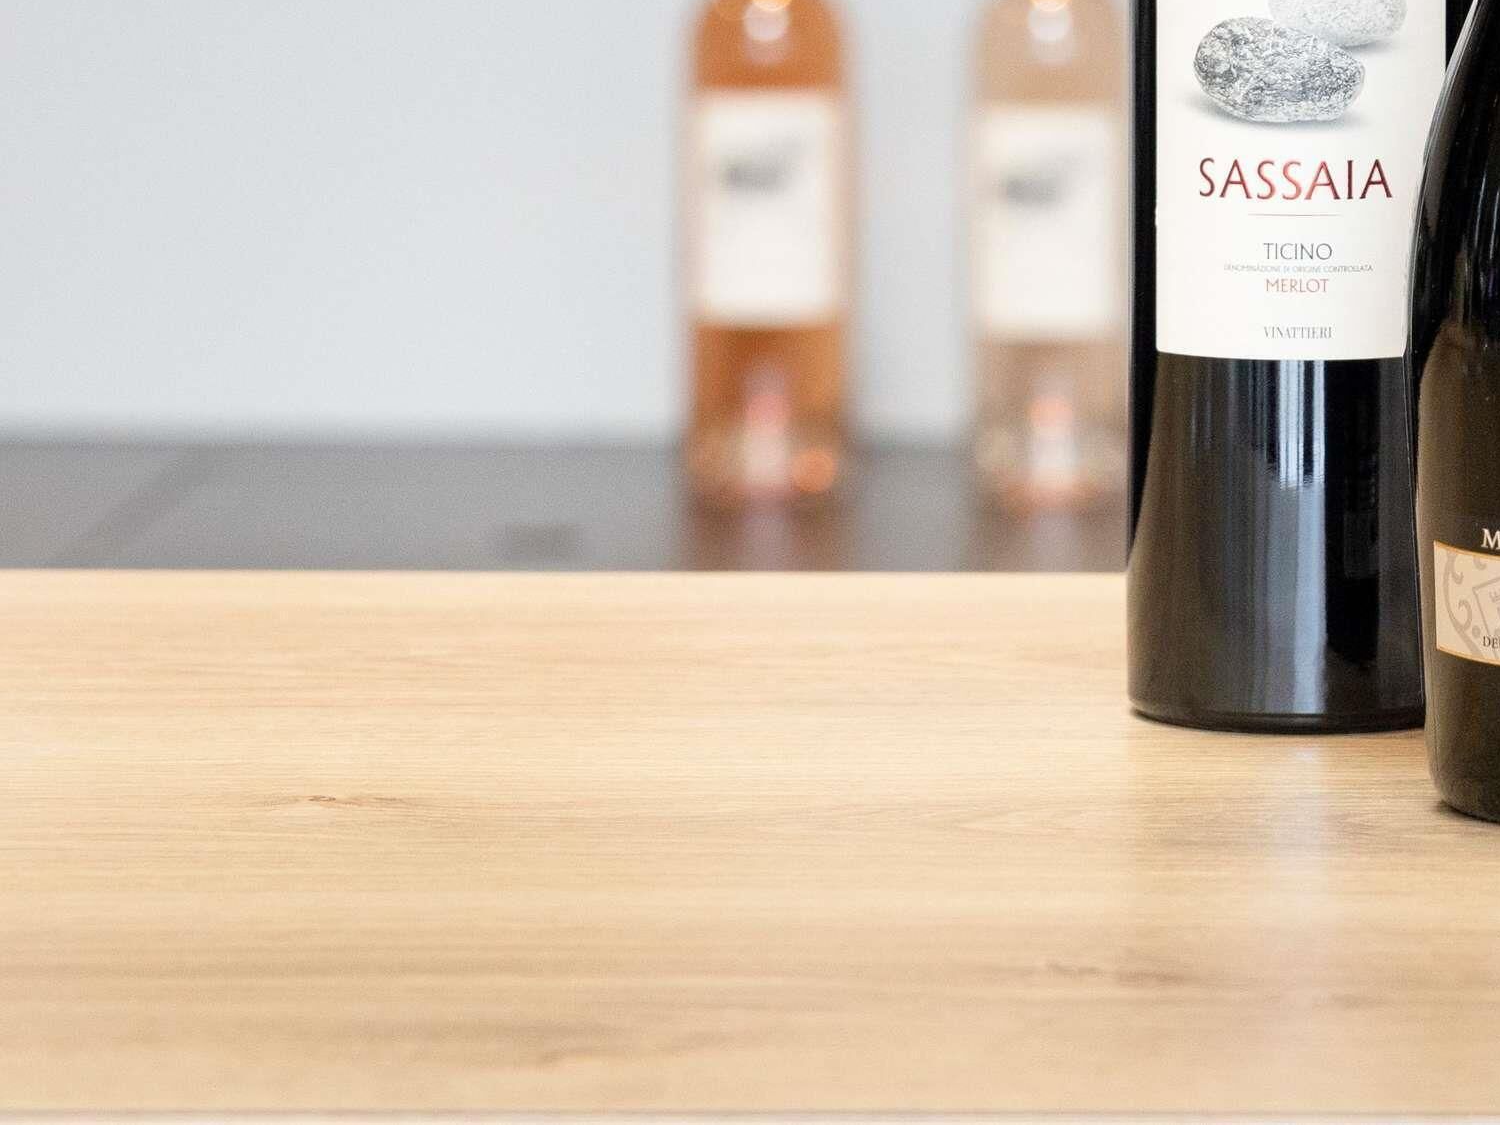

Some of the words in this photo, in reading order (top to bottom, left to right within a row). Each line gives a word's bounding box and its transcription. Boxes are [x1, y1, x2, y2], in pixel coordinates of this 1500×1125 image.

[1199, 157, 1393, 200] SASSAIA
[1263, 243, 1333, 260] TICINO
[1265, 278, 1330, 293] MERLOT
[1263, 326, 1333, 339] VINATTIERI
